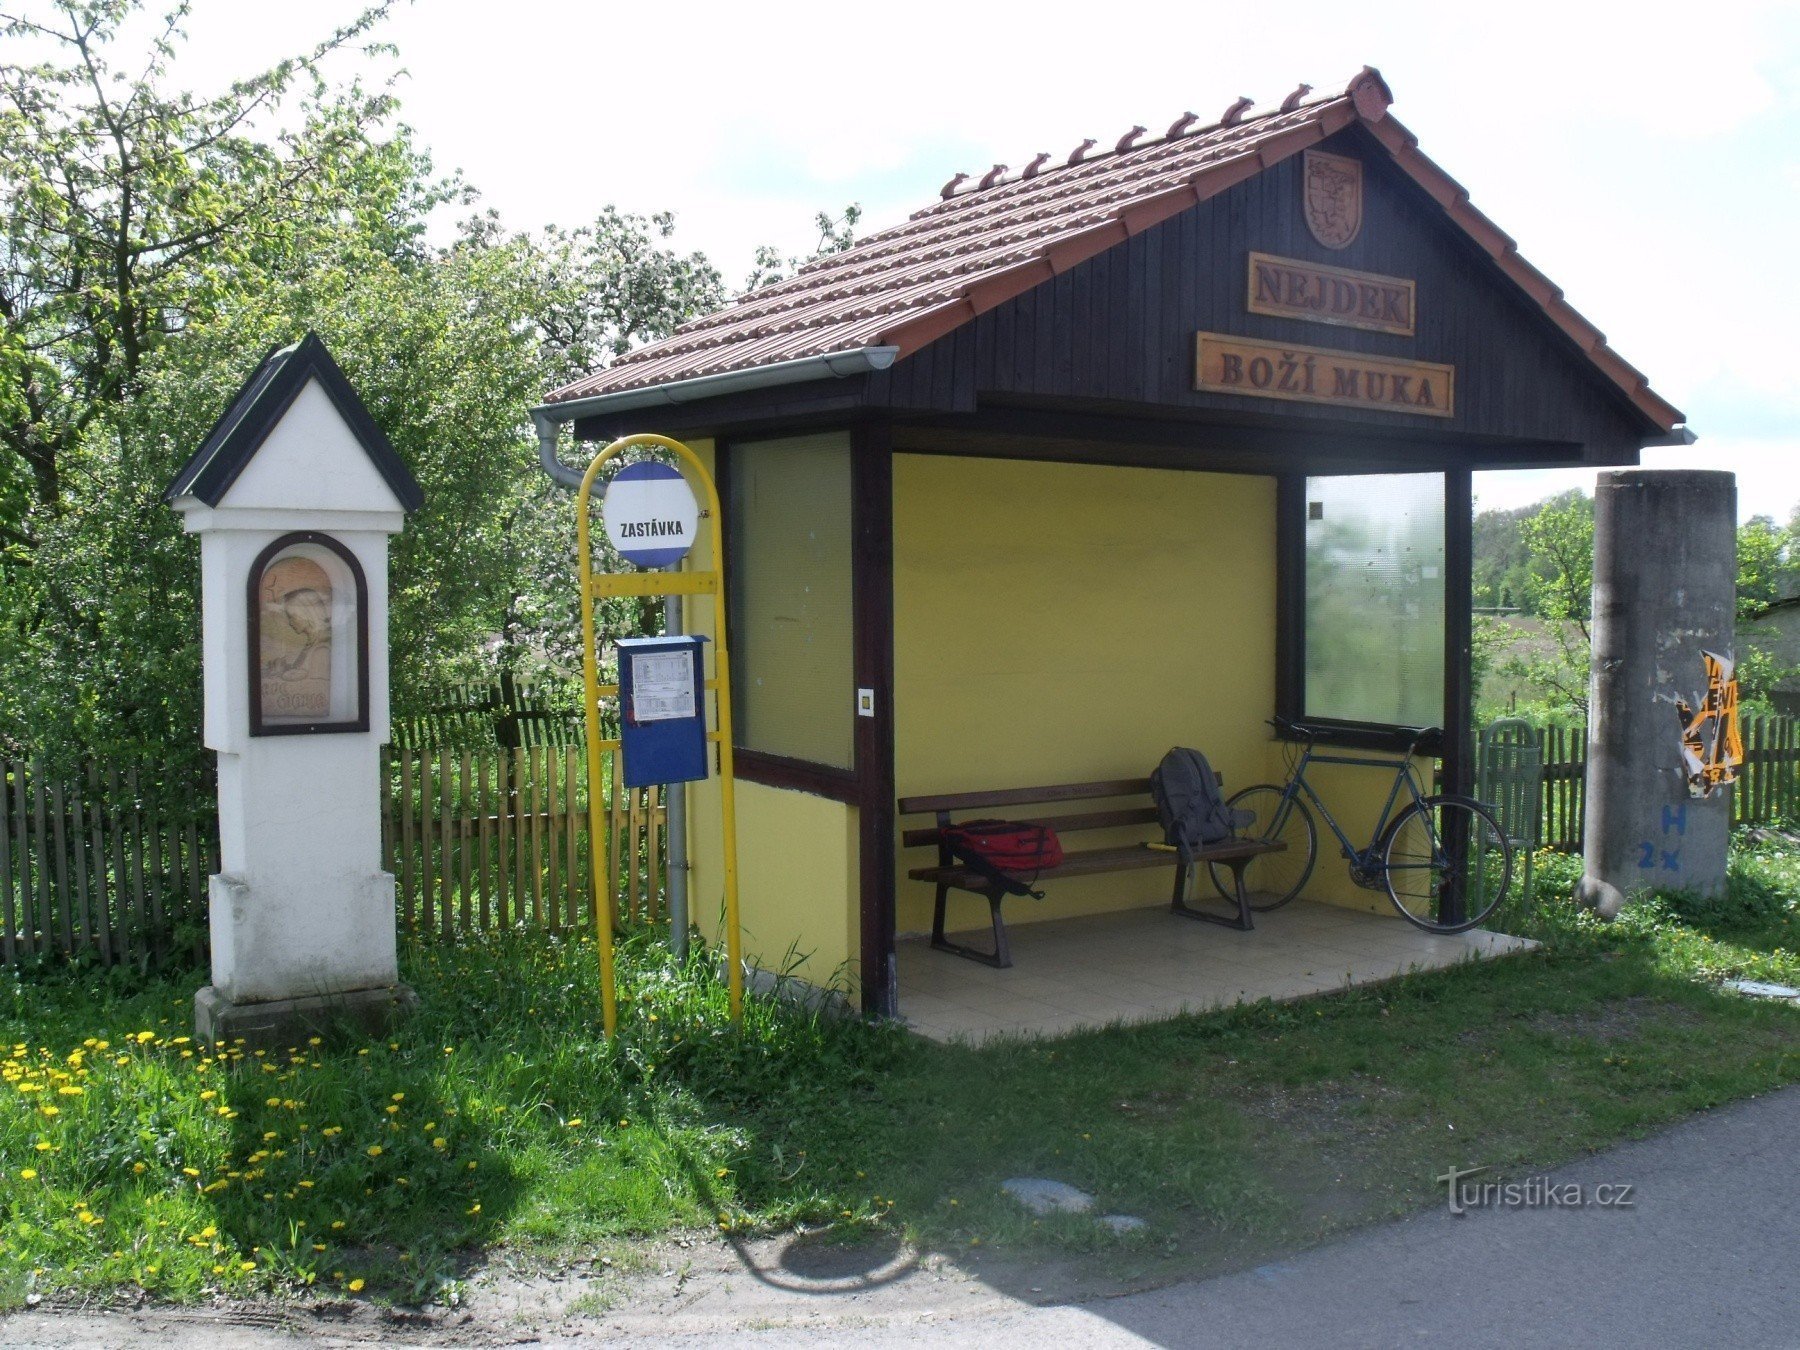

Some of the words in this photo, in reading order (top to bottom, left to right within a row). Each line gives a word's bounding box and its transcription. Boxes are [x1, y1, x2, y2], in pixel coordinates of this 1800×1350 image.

[1255, 264, 1408, 323] NEJDEK
[1221, 352, 1316, 394] BOŽÍ
[1333, 366, 1436, 408] MUKA
[620, 518, 684, 538] ZASTÁVKA
[1662, 803, 1687, 836] H
